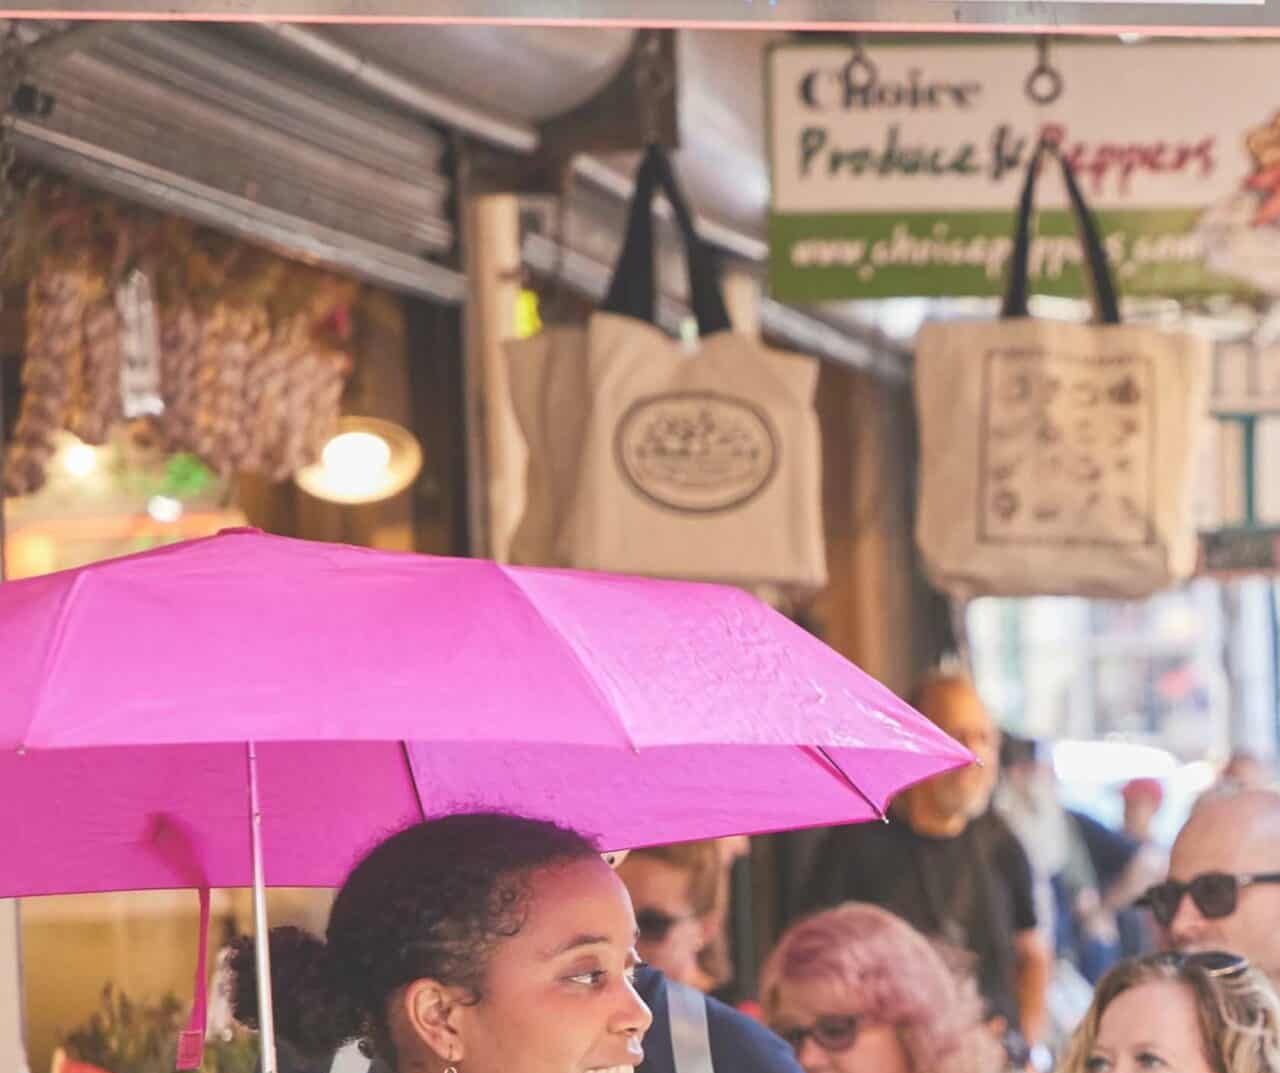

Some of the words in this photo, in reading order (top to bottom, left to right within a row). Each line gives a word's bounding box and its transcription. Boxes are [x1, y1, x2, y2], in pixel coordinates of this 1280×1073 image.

[798, 67, 981, 110] Choice
[800, 126, 979, 176] Produce
[1036, 122, 1217, 195] Peppers
